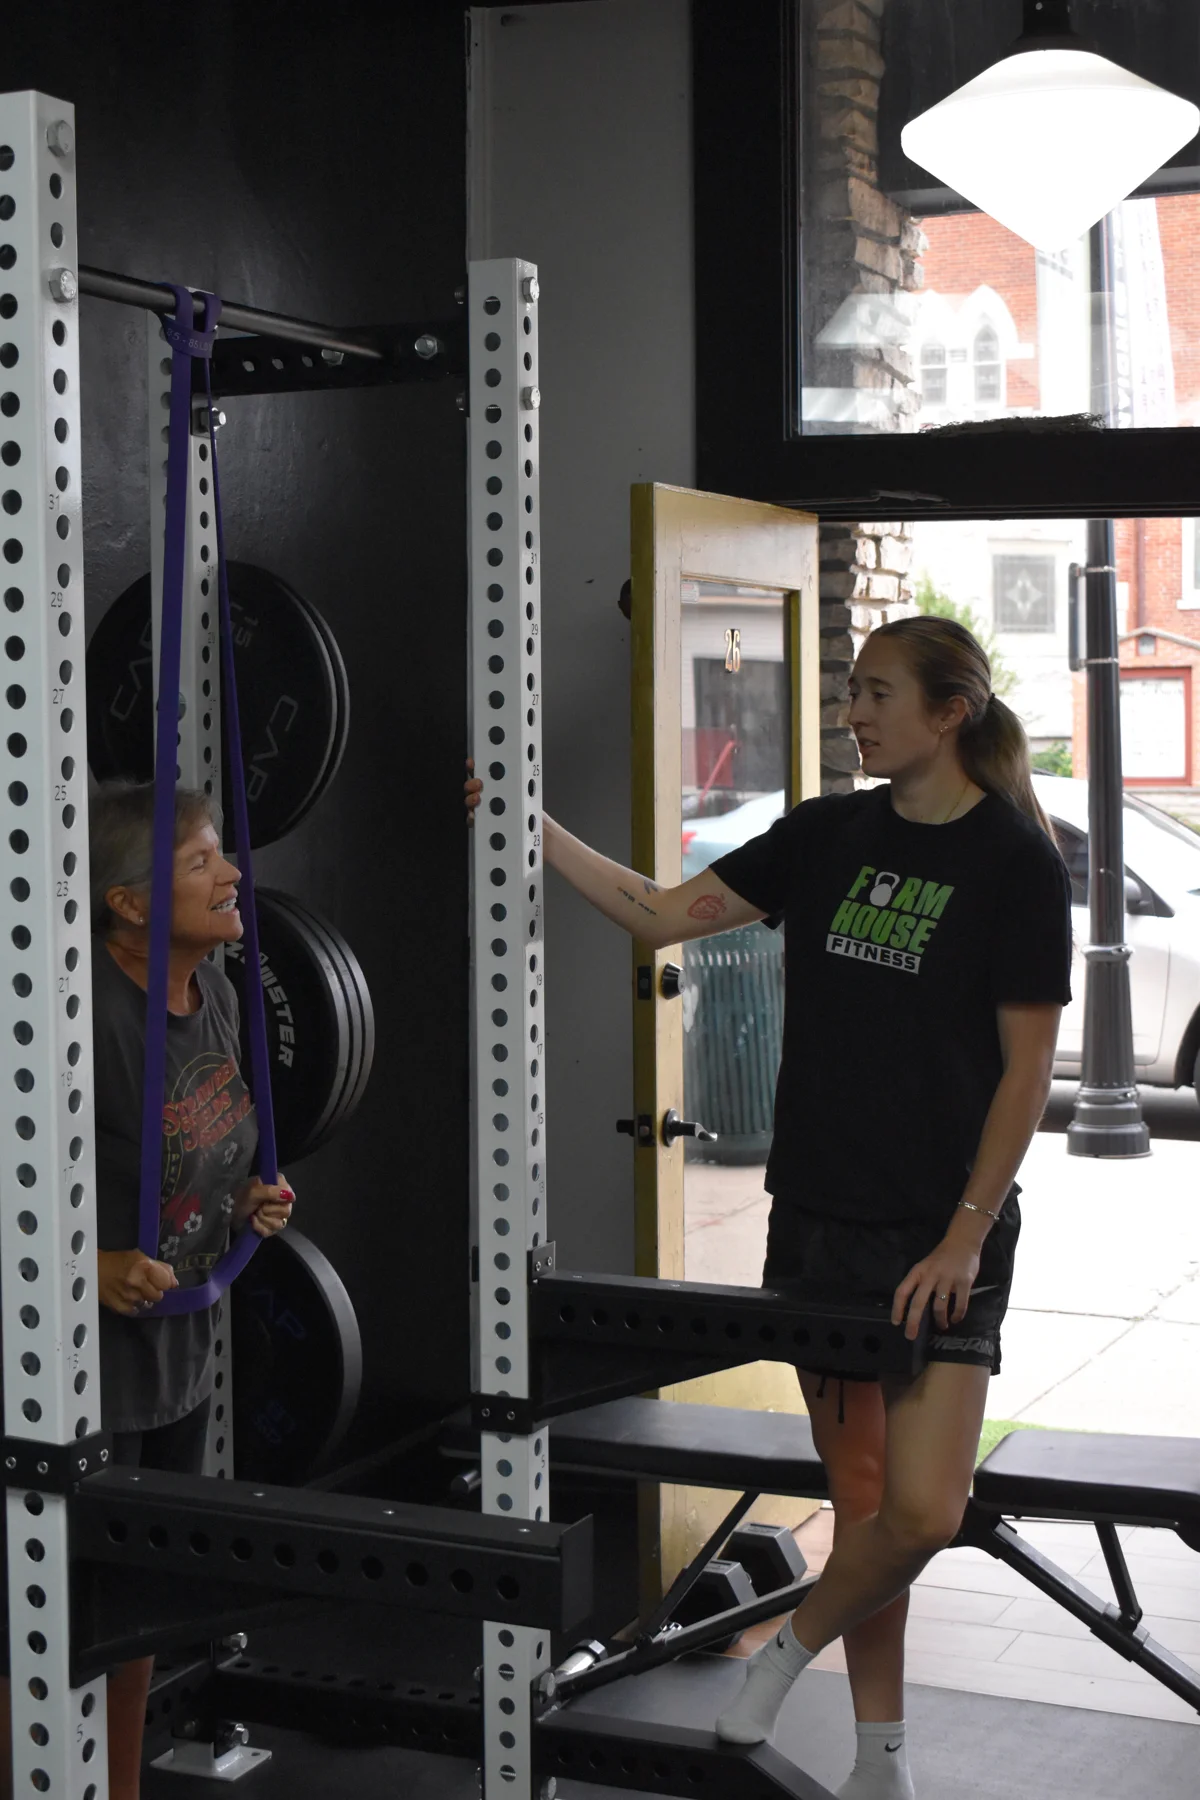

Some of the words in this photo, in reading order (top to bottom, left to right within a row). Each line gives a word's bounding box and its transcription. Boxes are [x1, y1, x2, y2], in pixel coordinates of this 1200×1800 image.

[50, 591, 64, 608] 29
[531, 623, 539, 635] 29
[52, 688, 65, 705] 27
[532, 694, 540, 706] 27
[532, 764, 540, 777] 25
[54, 785, 67, 801] 25
[533, 834, 541, 847] 23
[56, 881, 69, 897] 23
[829, 899, 938, 954] HOUSE
[830, 936, 917, 971] FITNESS
[58, 976, 70, 993] 21
[535, 974, 543, 987] 19
[60, 1071, 73, 1088] 19
[76, 1722, 84, 1743] 5
